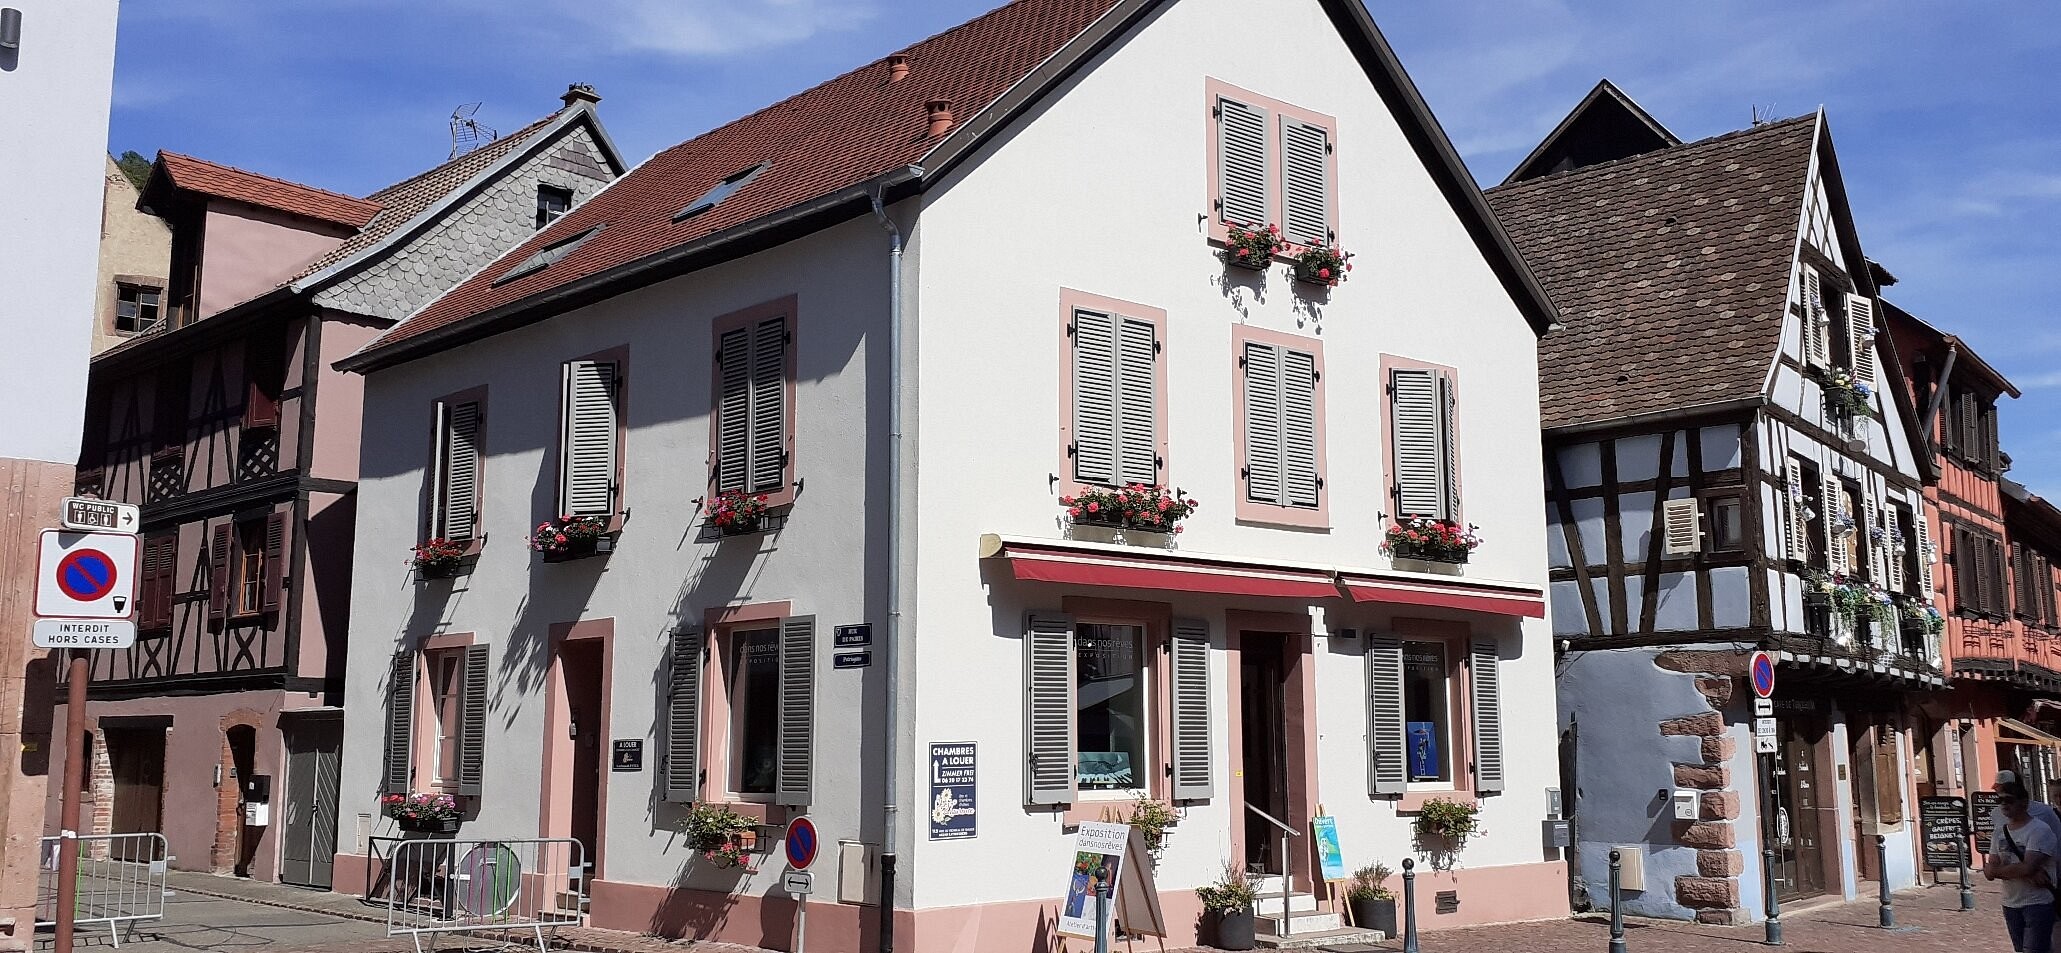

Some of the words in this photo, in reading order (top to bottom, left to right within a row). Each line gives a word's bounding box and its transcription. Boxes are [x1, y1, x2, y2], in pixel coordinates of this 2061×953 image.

[72, 502, 85, 510] WC
[87, 504, 115, 514] PUBLIC
[59, 624, 110, 633] INTERDIT
[48, 635, 78, 643] HORS
[84, 635, 119, 644] CASES
[932, 746, 974, 756] CHAMBRES
[942, 757, 949, 765] A
[950, 756, 974, 765] LOUER
[1080, 825, 1126, 840] Exposition
